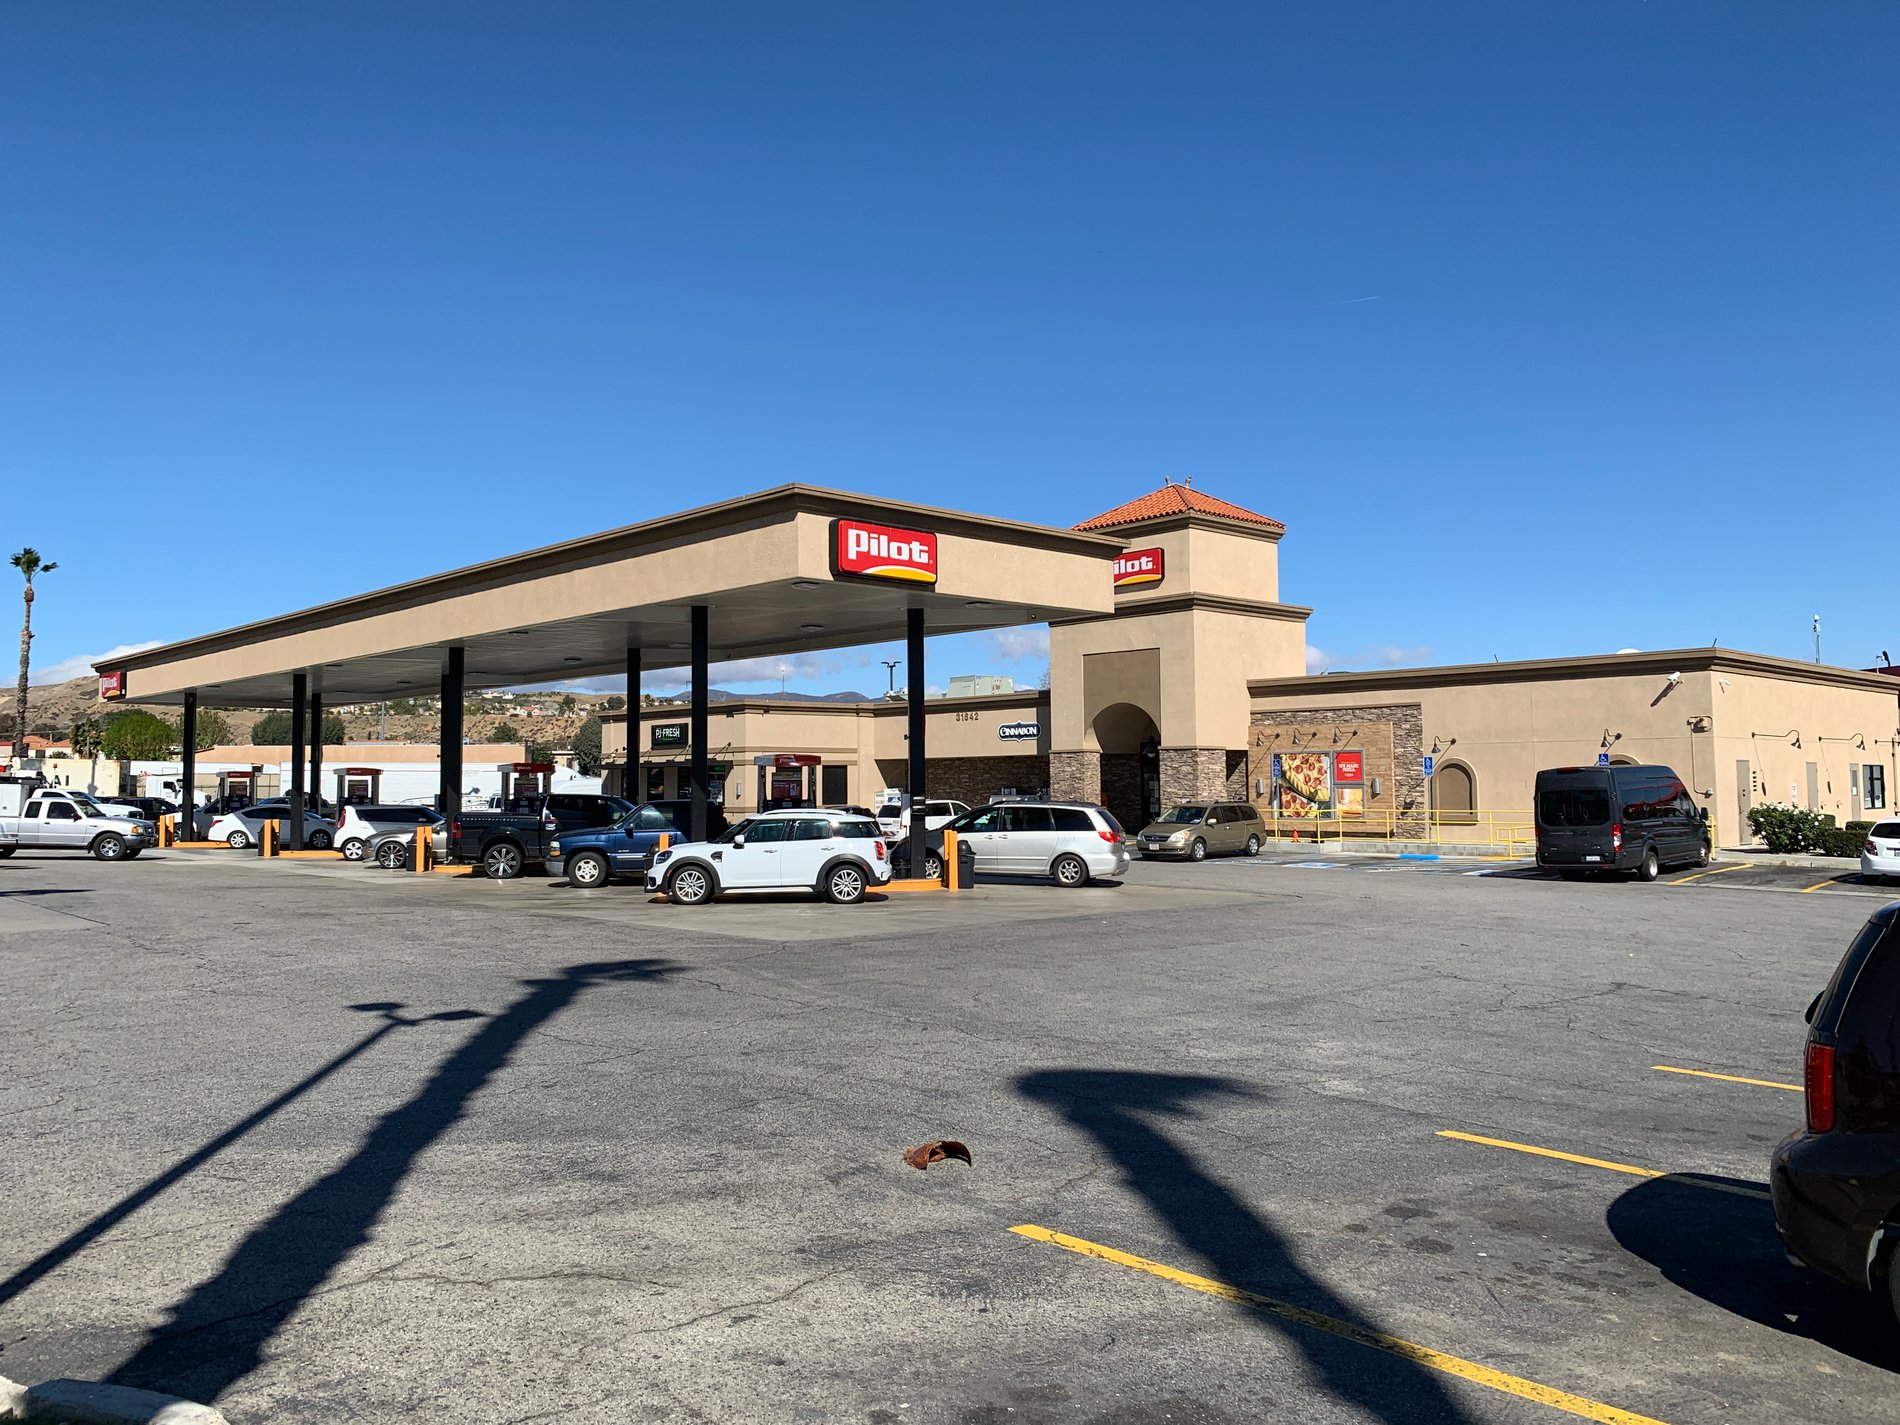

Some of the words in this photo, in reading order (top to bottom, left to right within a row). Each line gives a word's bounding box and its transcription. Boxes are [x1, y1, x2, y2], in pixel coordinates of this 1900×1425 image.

[847, 528, 929, 564] Pilot
[1113, 556, 1153, 575] ilot
[1000, 727, 1037, 737] CINNABON
